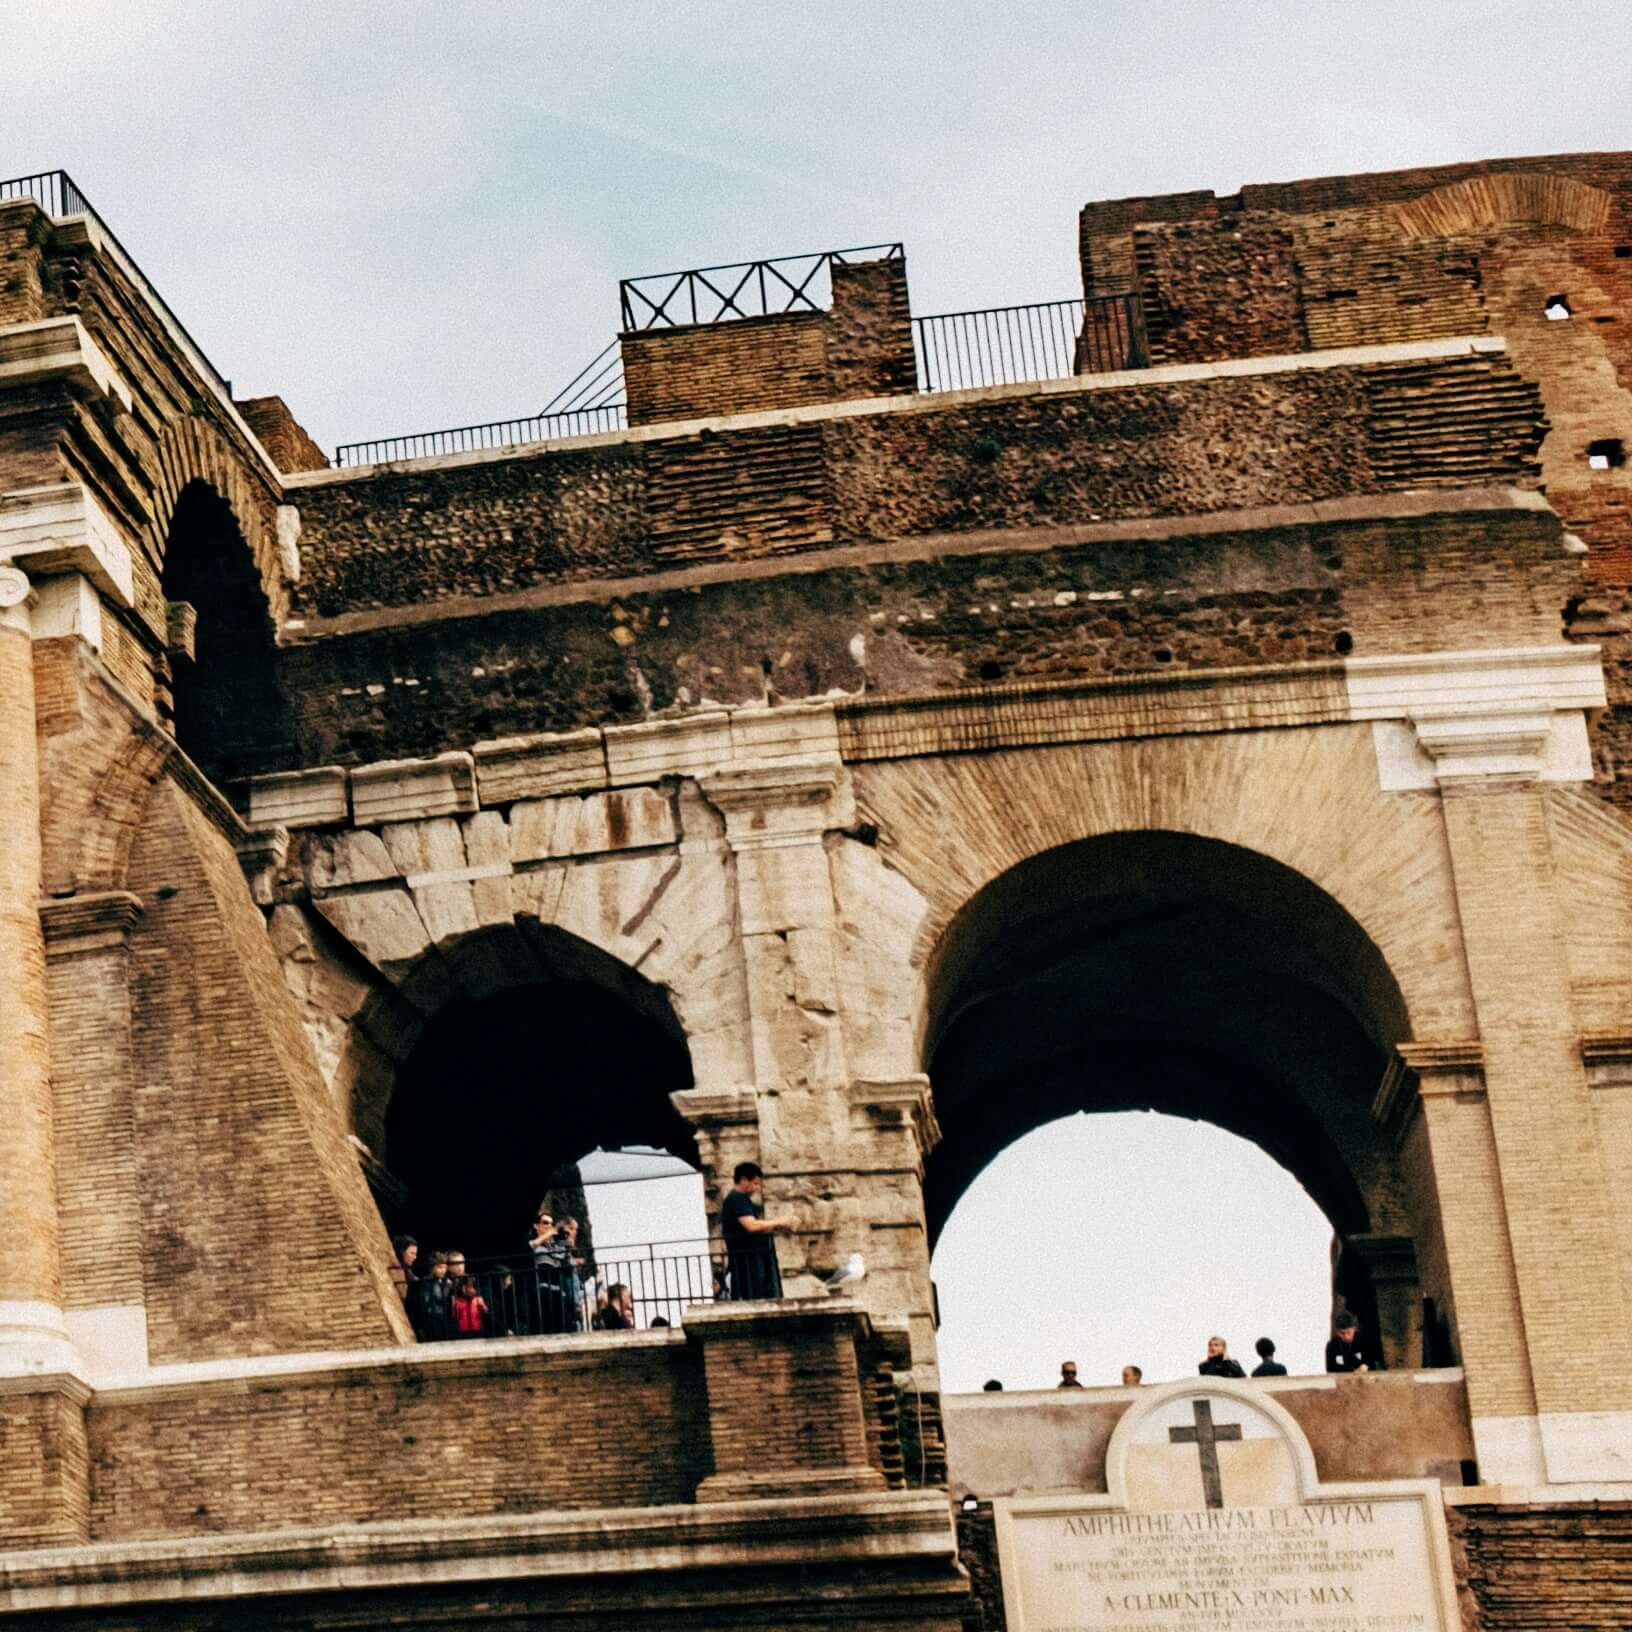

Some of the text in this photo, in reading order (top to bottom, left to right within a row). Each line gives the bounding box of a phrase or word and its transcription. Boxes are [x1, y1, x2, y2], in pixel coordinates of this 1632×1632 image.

[1064, 1510, 1255, 1537] AMPHITHEATRVM
[1269, 1504, 1375, 1528] FLAVIVM
[1310, 1585, 1355, 1604] MAX
